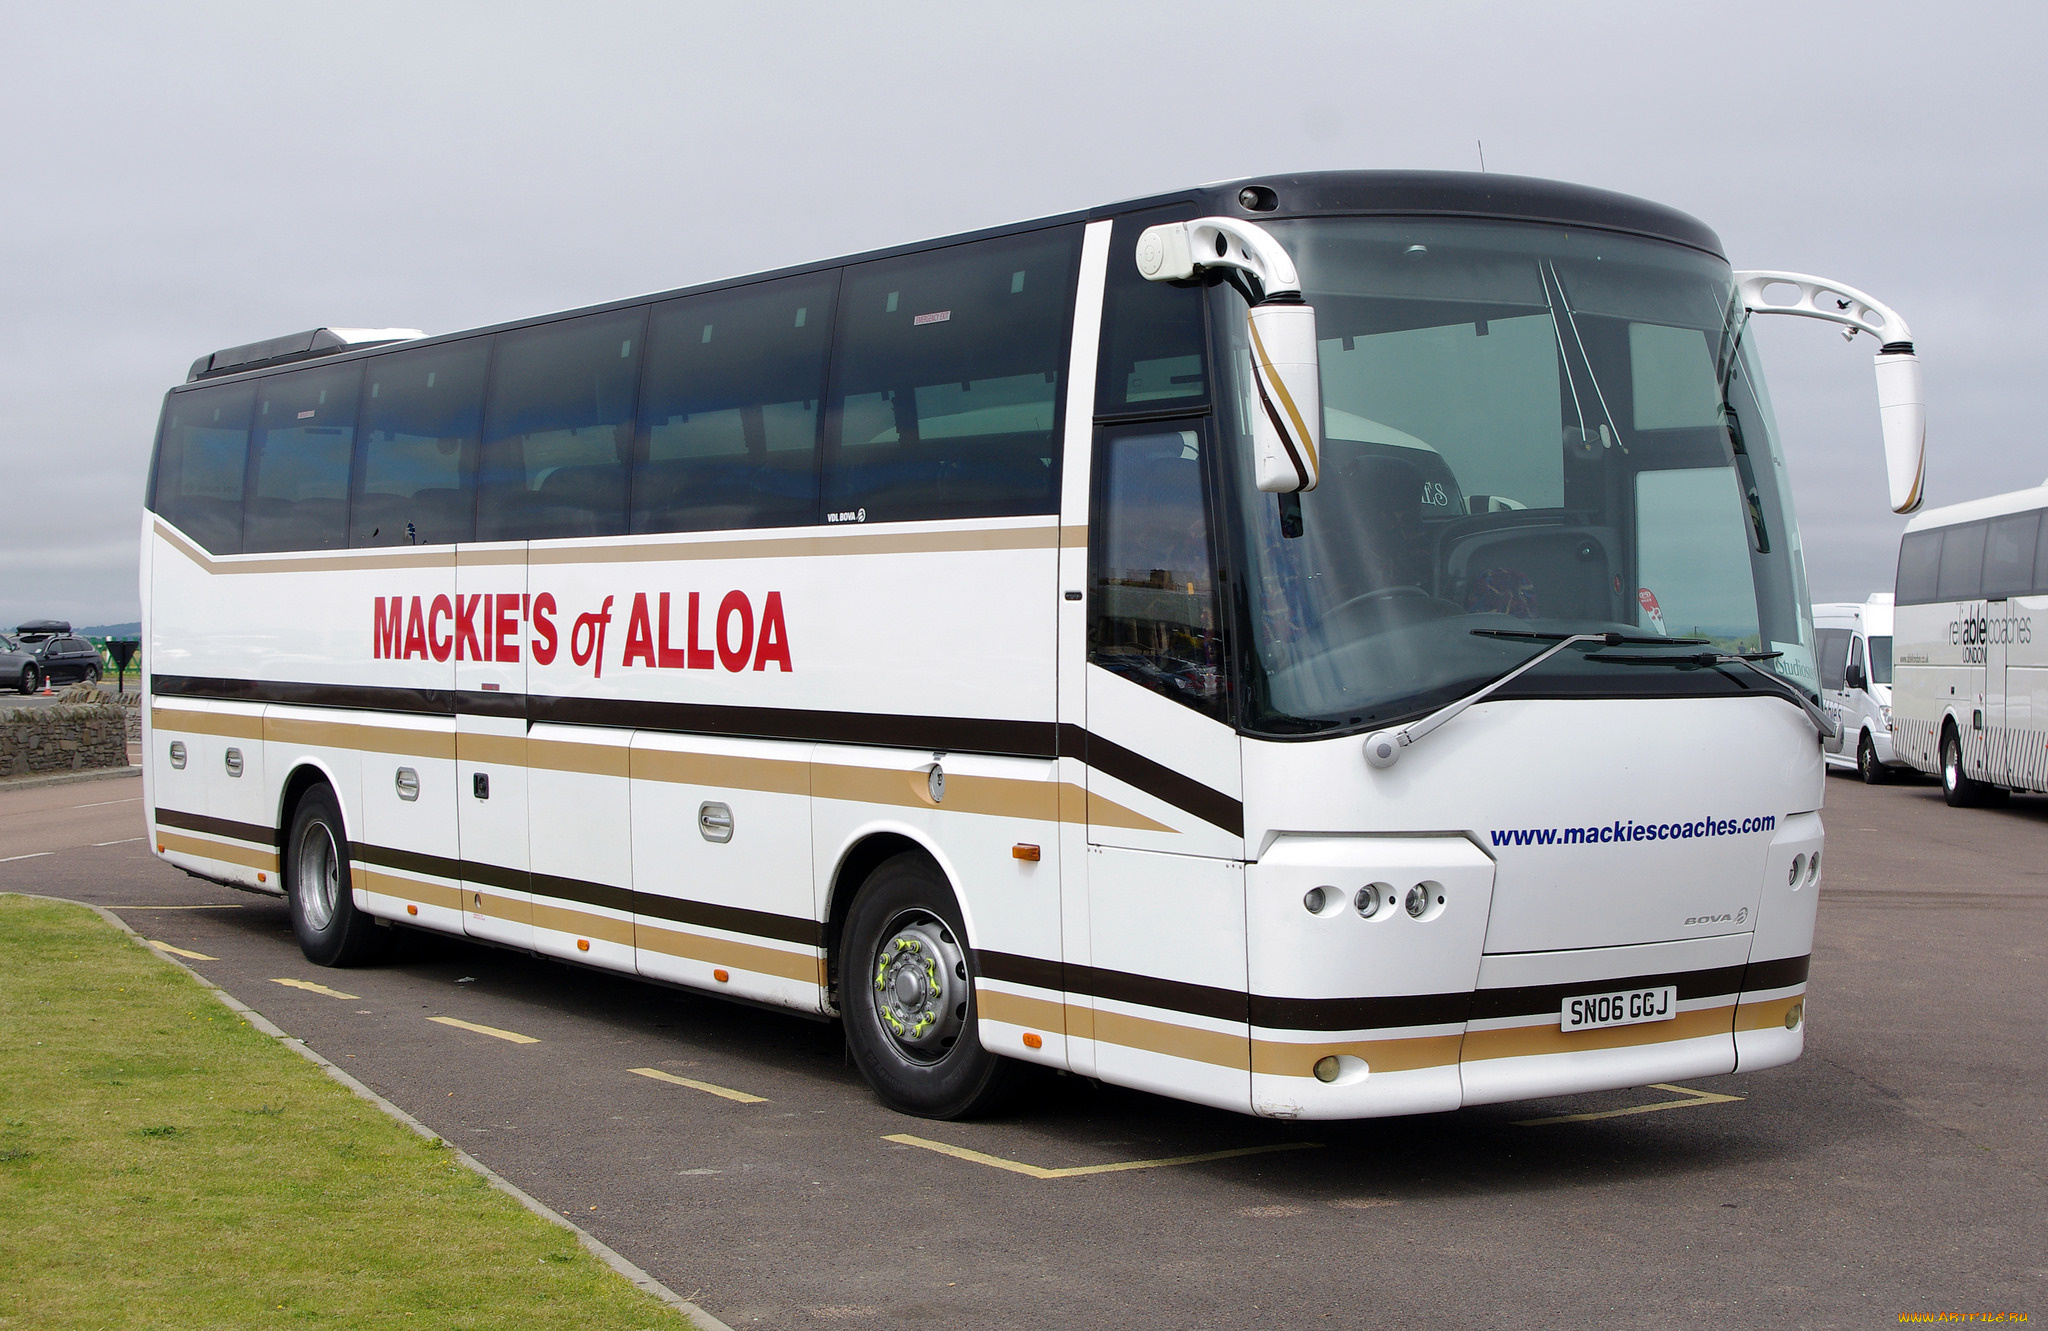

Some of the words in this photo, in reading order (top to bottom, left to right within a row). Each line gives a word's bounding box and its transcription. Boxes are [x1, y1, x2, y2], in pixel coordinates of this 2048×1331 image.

[827, 513, 839, 522] VDL
[840, 511, 856, 522] BOVA
[373, 592, 558, 666] MACKIE'S
[571, 594, 614, 678] of
[622, 589, 793, 673] ALLOA
[1963, 646, 1987, 664] LONDON
[1490, 814, 1776, 847] www.mackiescoaches.com
[1683, 913, 1732, 926] BOVA
[1570, 994, 1624, 1025] SN06
[1629, 990, 1668, 1019] GGJ
